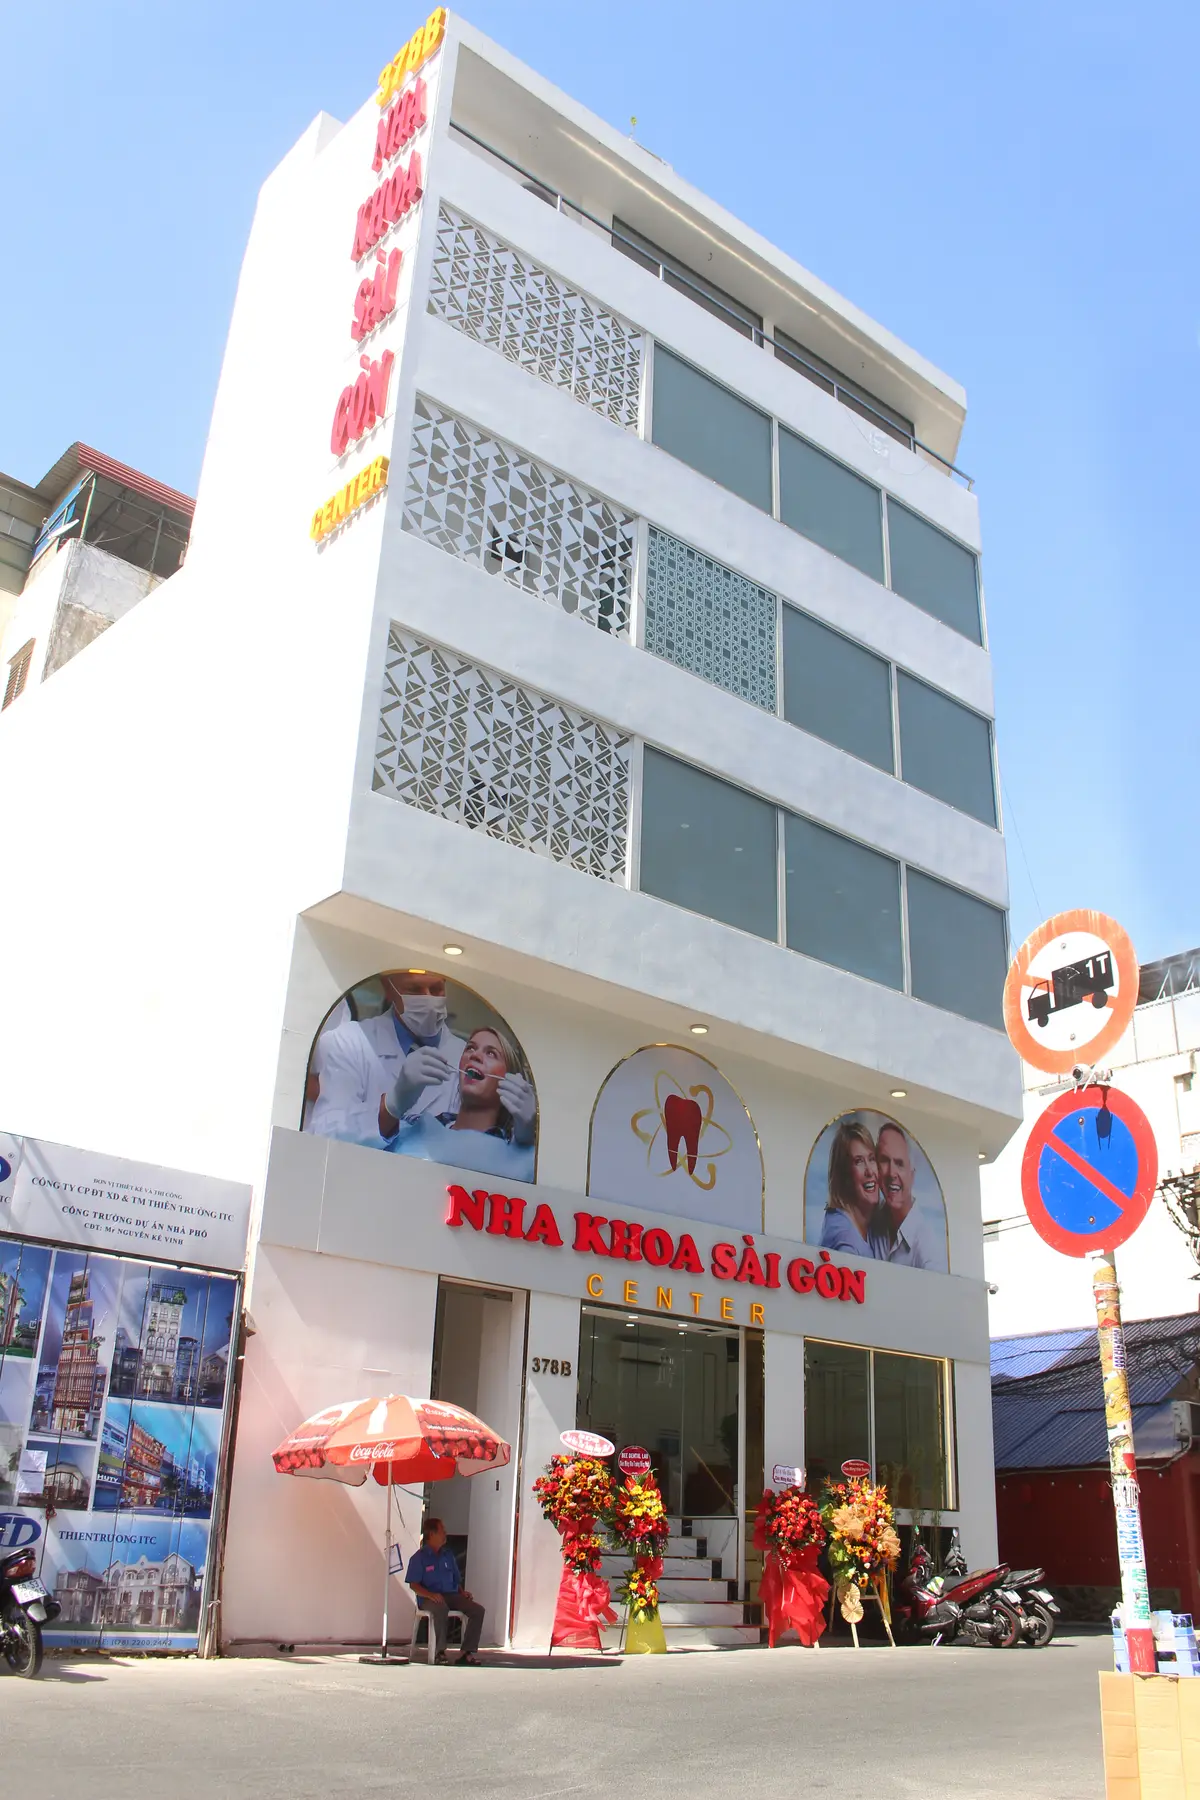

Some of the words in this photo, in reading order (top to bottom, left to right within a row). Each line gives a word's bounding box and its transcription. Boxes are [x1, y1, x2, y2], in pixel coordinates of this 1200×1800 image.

[376, 6, 446, 108] 378B
[371, 77, 427, 173] NHA
[351, 150, 423, 263] KHOA
[351, 246, 403, 343] SÀI
[331, 348, 394, 458] GÒN
[310, 455, 390, 543] CENTER
[1085, 953, 1109, 979] 1T
[31, 1177, 60, 1190] CÔNG
[62, 1182, 76, 1192] TY
[77, 1185, 91, 1196] CP
[106, 1191, 120, 1201] XD
[121, 1194, 129, 1203] &
[132, 1195, 146, 1206] TM
[148, 1199, 177, 1212] THIÊN
[218, 1213, 234, 1222] ITC
[61, 1205, 90, 1217] CÔNG
[151, 1221, 165, 1230] ÁN
[166, 1225, 186, 1235] NHÀ
[164, 1236, 184, 1245] VINH
[445, 1184, 564, 1247] NHA
[572, 1212, 704, 1274] KHOA
[711, 1234, 782, 1289] SÀI
[787, 1250, 867, 1304] GÒN
[586, 1273, 766, 1326] CENTER
[532, 1356, 572, 1377] 378B
[349, 1441, 396, 1461] Coca-Cola
[59, 1530, 138, 1544] THIENTRUONG
[138, 1535, 157, 1545] ITC
